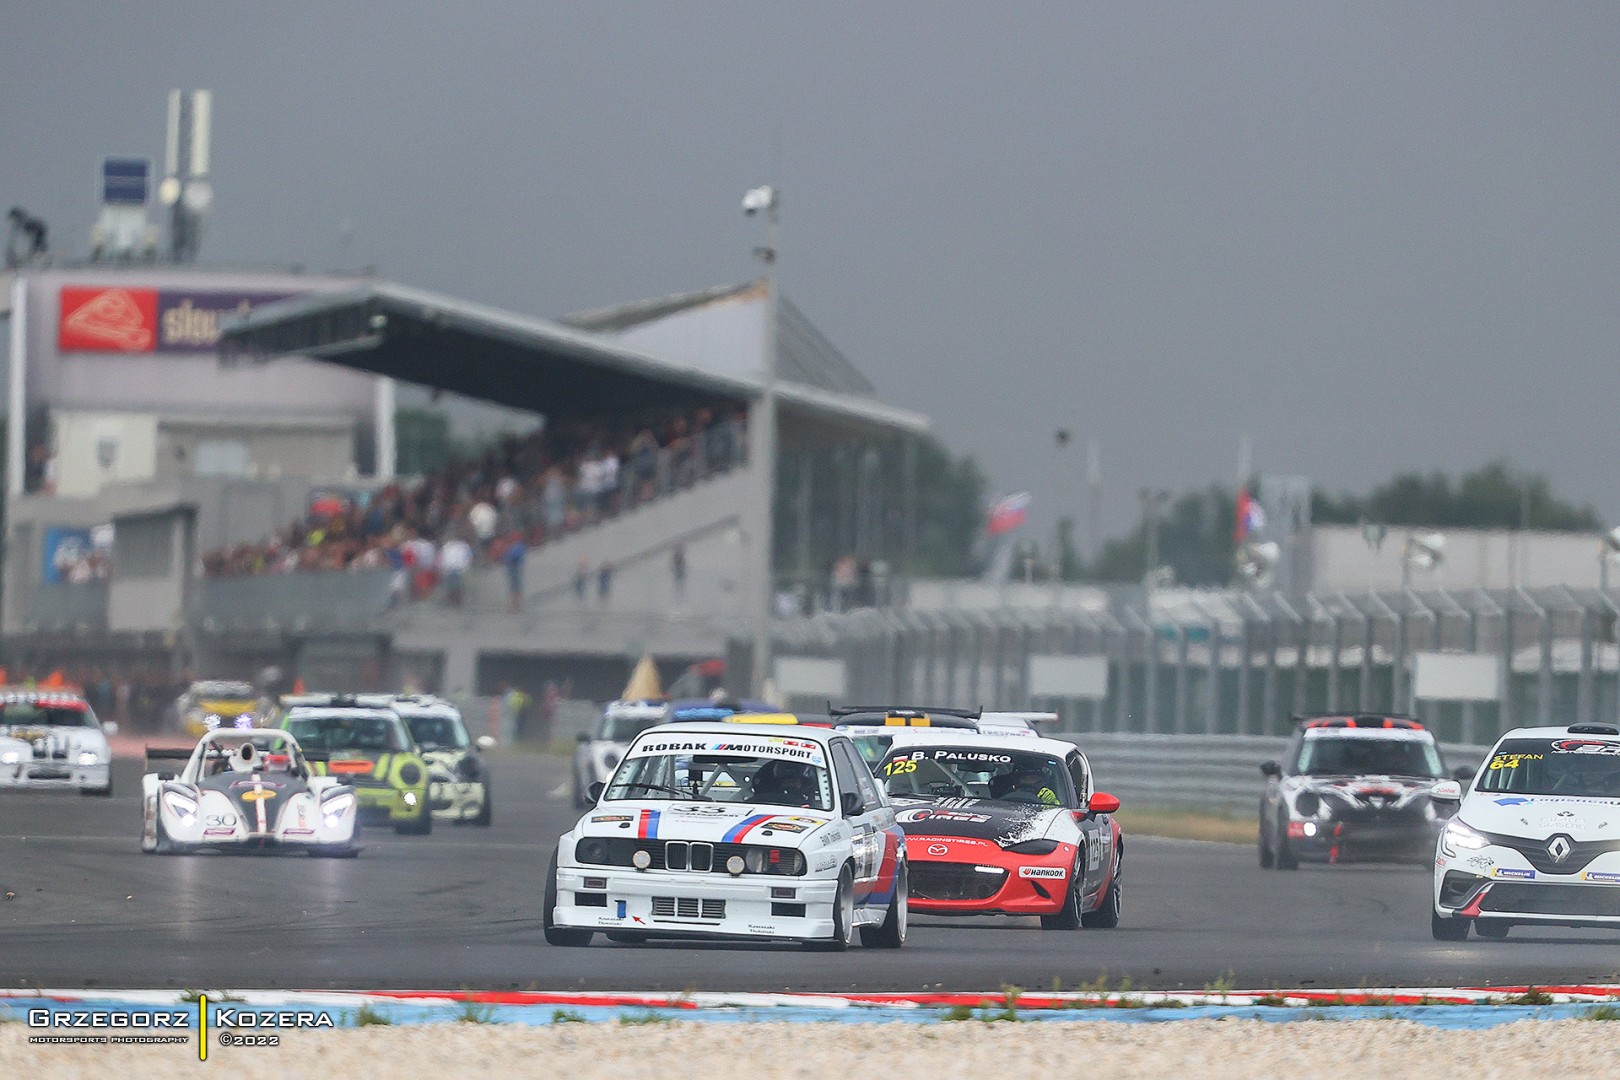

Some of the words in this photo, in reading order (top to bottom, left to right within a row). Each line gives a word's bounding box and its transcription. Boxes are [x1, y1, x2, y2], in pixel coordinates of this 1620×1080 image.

[642, 742, 707, 753] ROBAK
[911, 751, 929, 761] B.
[1493, 753, 1544, 762] STEFAN
[883, 759, 918, 777] 125
[1489, 759, 1520, 770] 64
[206, 813, 237, 827] 30
